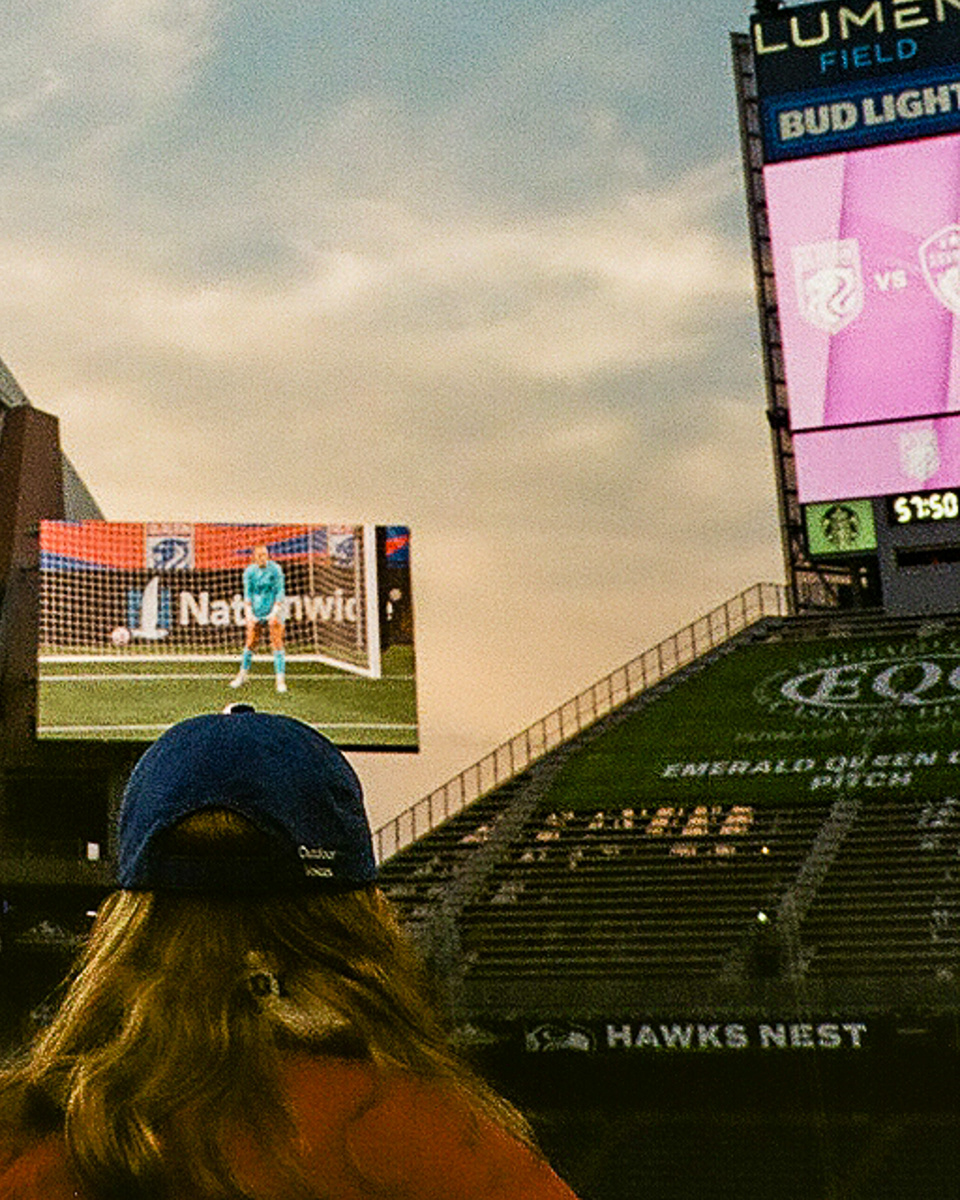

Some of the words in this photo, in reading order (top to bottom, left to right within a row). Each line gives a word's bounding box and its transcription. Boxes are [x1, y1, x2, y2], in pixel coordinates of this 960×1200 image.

[820, 38, 917, 73] FIELD
[778, 102, 858, 141] BUD
[894, 492, 959, 523] 57:50
[808, 658, 960, 705] EQ
[660, 758, 816, 778] EMERALD
[824, 751, 939, 772] QUEEN
[810, 771, 914, 790] PITCH
[605, 1023, 749, 1048] HAWKS
[759, 1023, 868, 1048] NEST
